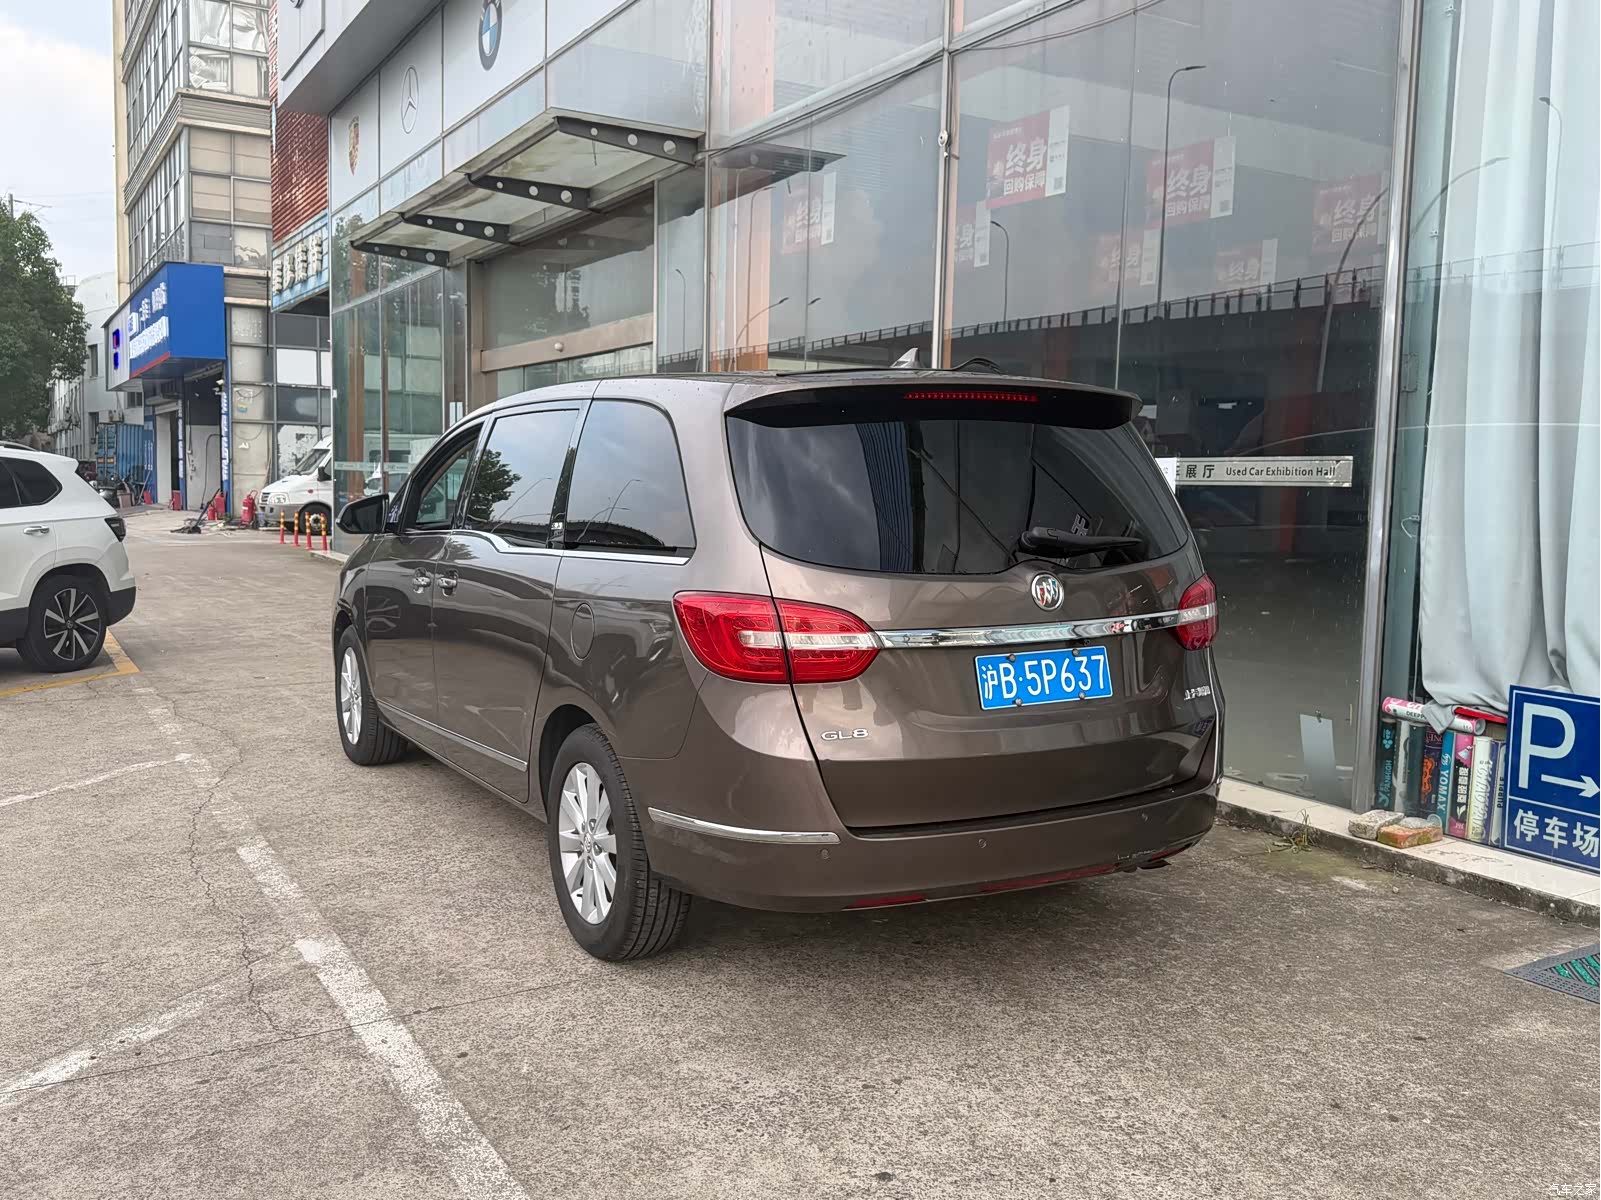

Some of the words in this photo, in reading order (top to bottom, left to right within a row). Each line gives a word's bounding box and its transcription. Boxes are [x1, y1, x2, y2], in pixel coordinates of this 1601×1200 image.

[1005, 137, 1047, 176] 终身
[1176, 464, 1215, 479] 展厅
[1225, 466, 1248, 477] Used
[1249, 466, 1265, 477] Car
[1265, 466, 1314, 477] Exhibition
[1316, 466, 1336, 477] Hall
[981, 654, 1105, 700] 沪B·5P637
[821, 728, 869, 741] GL8
[1518, 702, 1576, 790] P
[1437, 770, 1449, 811] YOMAX
[1513, 808, 1600, 858] 停车场
